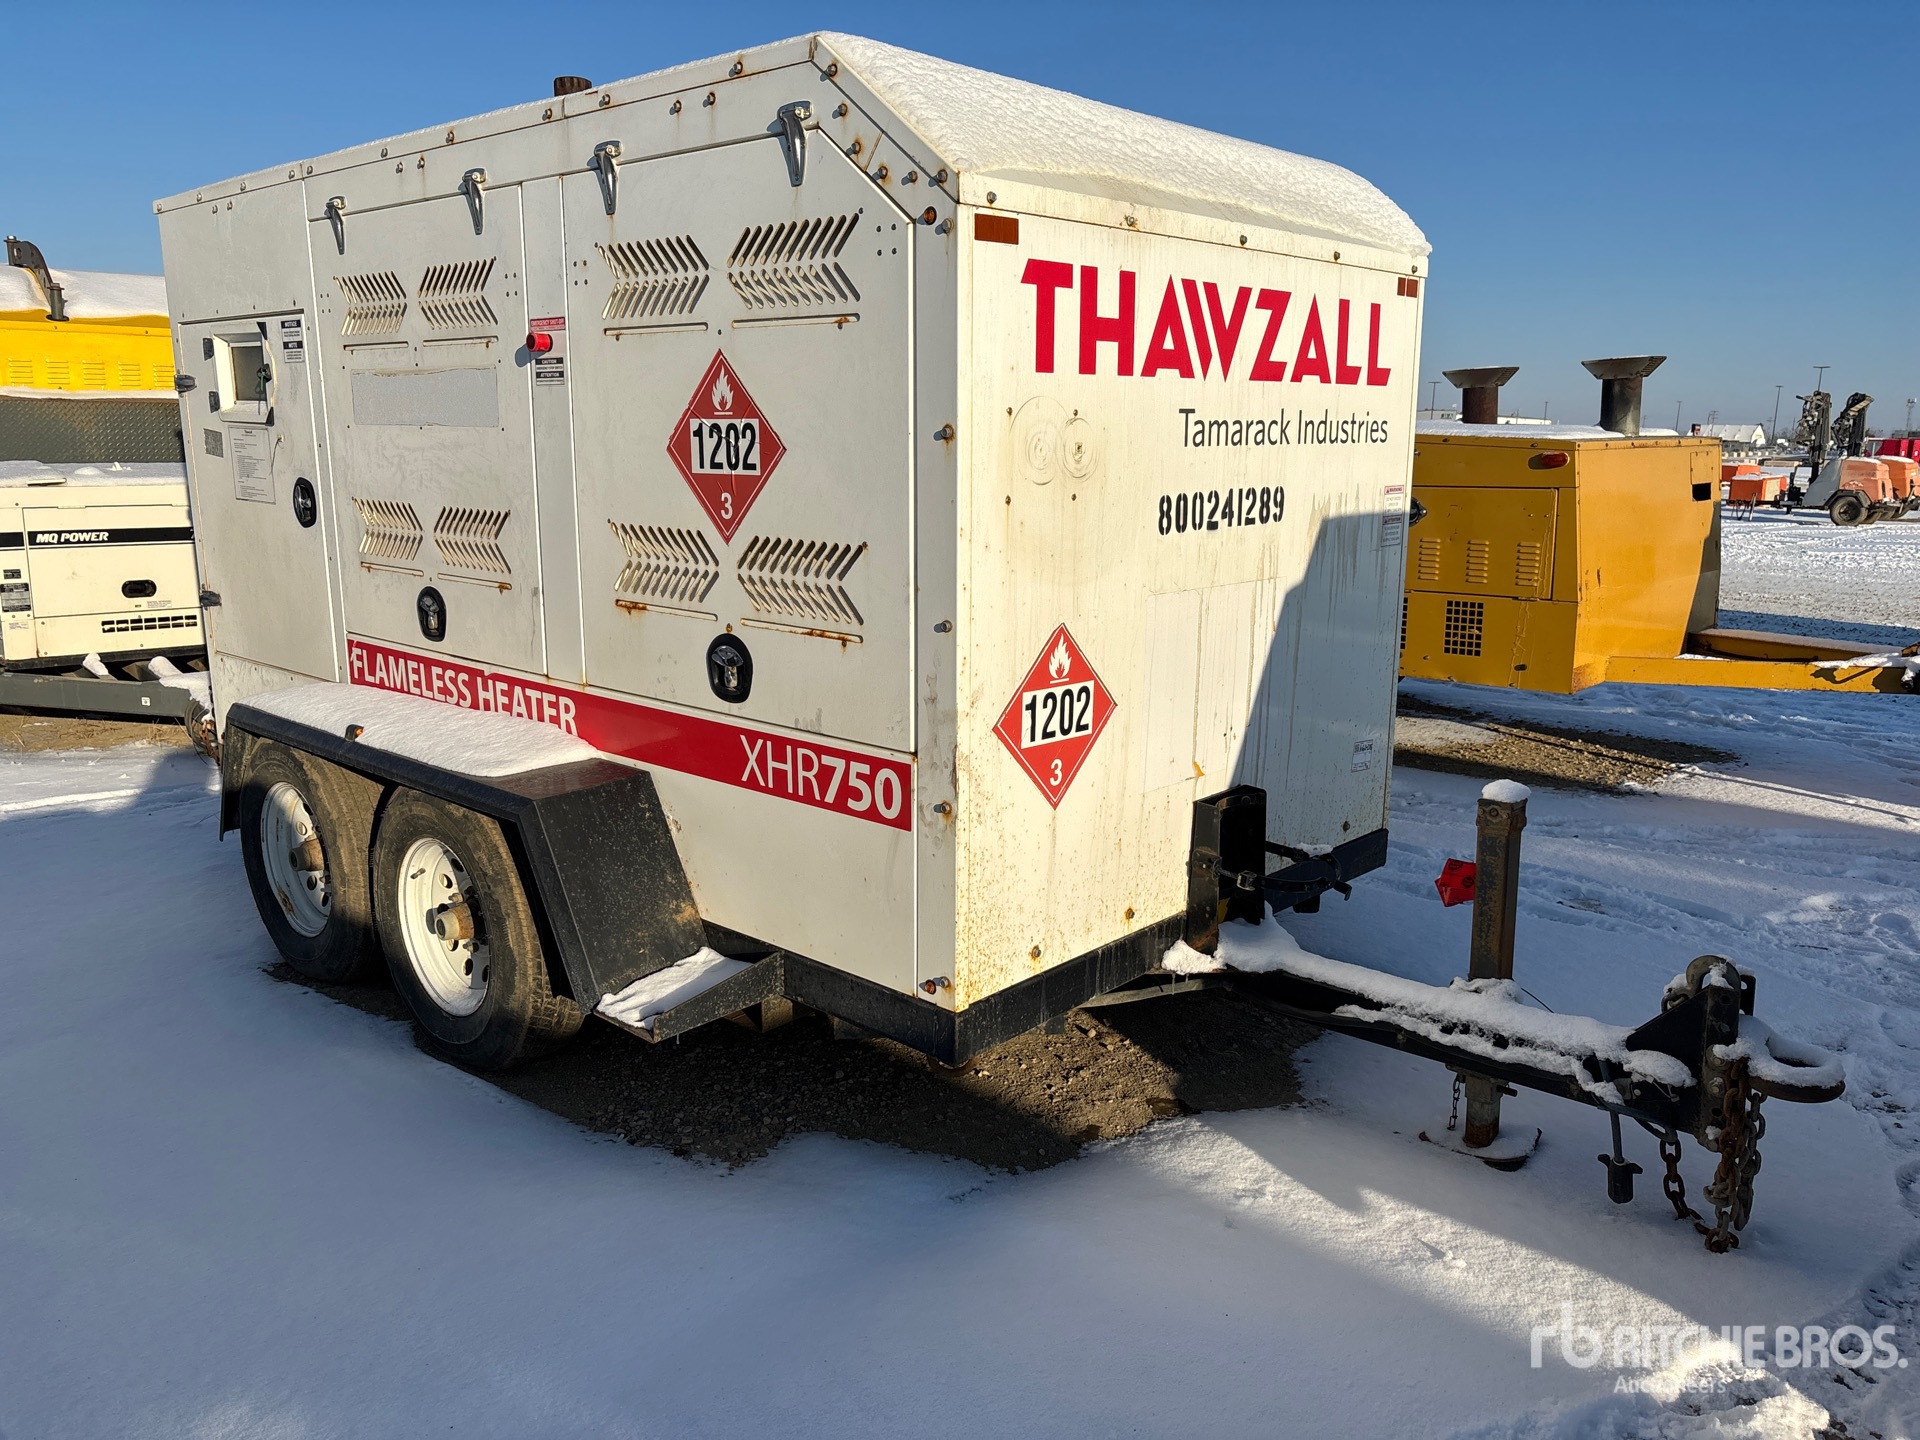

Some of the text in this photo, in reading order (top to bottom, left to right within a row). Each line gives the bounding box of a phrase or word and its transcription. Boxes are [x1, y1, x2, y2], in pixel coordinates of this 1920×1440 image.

[1021, 259, 1391, 386] THAWZALL
[692, 422, 757, 472] 1202
[1179, 409, 1388, 447] Tamarack Industries
[720, 492, 733, 520] 3
[1158, 486, 1285, 536] 800241289
[36, 532, 109, 543] MQ POWER
[351, 647, 579, 737] FLAMELESS HEATER
[1025, 685, 1091, 743] 1202
[739, 734, 903, 820] XHR750
[1049, 759, 1063, 787] 3
